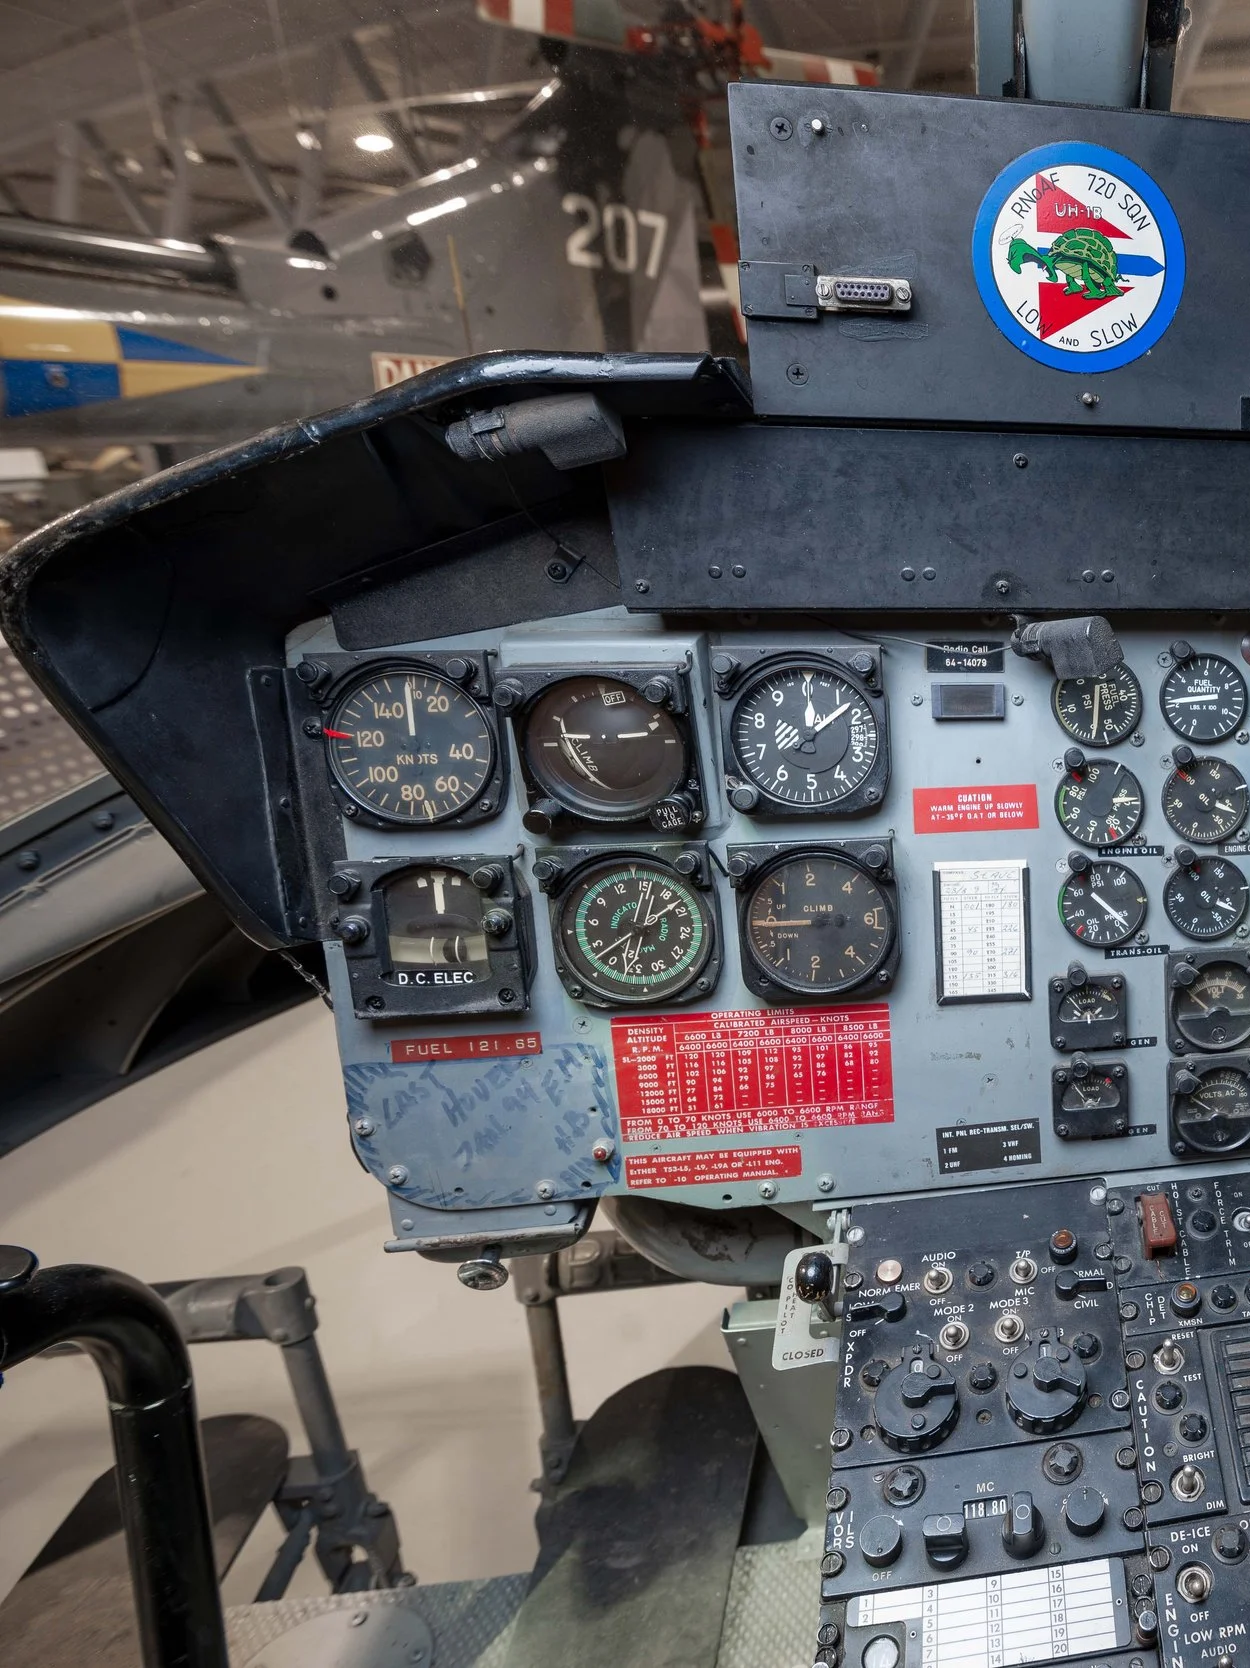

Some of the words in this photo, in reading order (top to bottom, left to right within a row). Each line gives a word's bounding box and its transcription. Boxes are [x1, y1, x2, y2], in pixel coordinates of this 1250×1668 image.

[1086, 172, 1116, 200] 720
[1117, 189, 1151, 233] SQN
[1054, 202, 1103, 220] UH-1B
[562, 194, 668, 279] 207
[1015, 300, 1053, 336] LOW
[1059, 335, 1080, 347] AND
[1090, 312, 1139, 349] SLOW
[604, 692, 622, 704] OFF
[374, 702, 404, 719] 140
[426, 696, 450, 713] 20
[356, 730, 384, 747] 120
[449, 743, 474, 760] 40
[368, 766, 398, 783] 100
[435, 776, 459, 792] 60
[400, 784, 425, 801] 80
[656, 805, 679, 817] PULL
[957, 803, 981, 811] ENGINE
[661, 817, 684, 828] CAGE
[1101, 847, 1138, 855] ENGINE
[711, 1009, 762, 1019] OPERATING
[767, 1008, 795, 1016] LIMITS
[714, 1019, 766, 1029] CALIBRATED
[820, 1014, 849, 1023] KNOTS
[627, 1027, 664, 1035] DENSITY
[627, 1035, 667, 1043] ALTITUDE
[405, 1044, 453, 1055] FUEL
[628, 1157, 647, 1165] THIS
[652, 1154, 692, 1163] AIRCRAFT
[732, 1148, 772, 1157] EQUIPPED
[921, 1251, 956, 1262] AUDIO
[1015, 1250, 1031, 1259] I/P
[1040, 1265, 1056, 1274] OFF
[858, 1288, 891, 1298] NORM
[894, 1282, 921, 1292] EMER
[1015, 1287, 1035, 1296] MIC
[929, 1297, 946, 1306] OFF
[989, 1299, 1018, 1309] MODE
[1022, 1297, 1029, 1306] 3
[1074, 1300, 1100, 1309] CIVIL
[933, 1306, 962, 1317] MODE
[967, 1304, 974, 1313] 2
[1178, 1318, 1203, 1328] XMSN
[1171, 1331, 1194, 1342] RESET
[782, 1348, 824, 1361] CLOSED
[1002, 1346, 1019, 1355] OFF
[946, 1354, 963, 1363] OFF
[1183, 1373, 1202, 1382] TEST
[1183, 1451, 1215, 1463] BRIGHT
[976, 1482, 995, 1493] MC
[964, 1499, 1006, 1518] 118.80
[1206, 1500, 1224, 1510] DIM
[1170, 1526, 1211, 1543] DE-ICE
[872, 1571, 892, 1581] OFF
[1190, 1610, 1210, 1622] OFF
[1183, 1628, 1216, 1645] LOW
[1218, 1624, 1247, 1639] RPM
[1200, 1643, 1237, 1659] AUDIO
